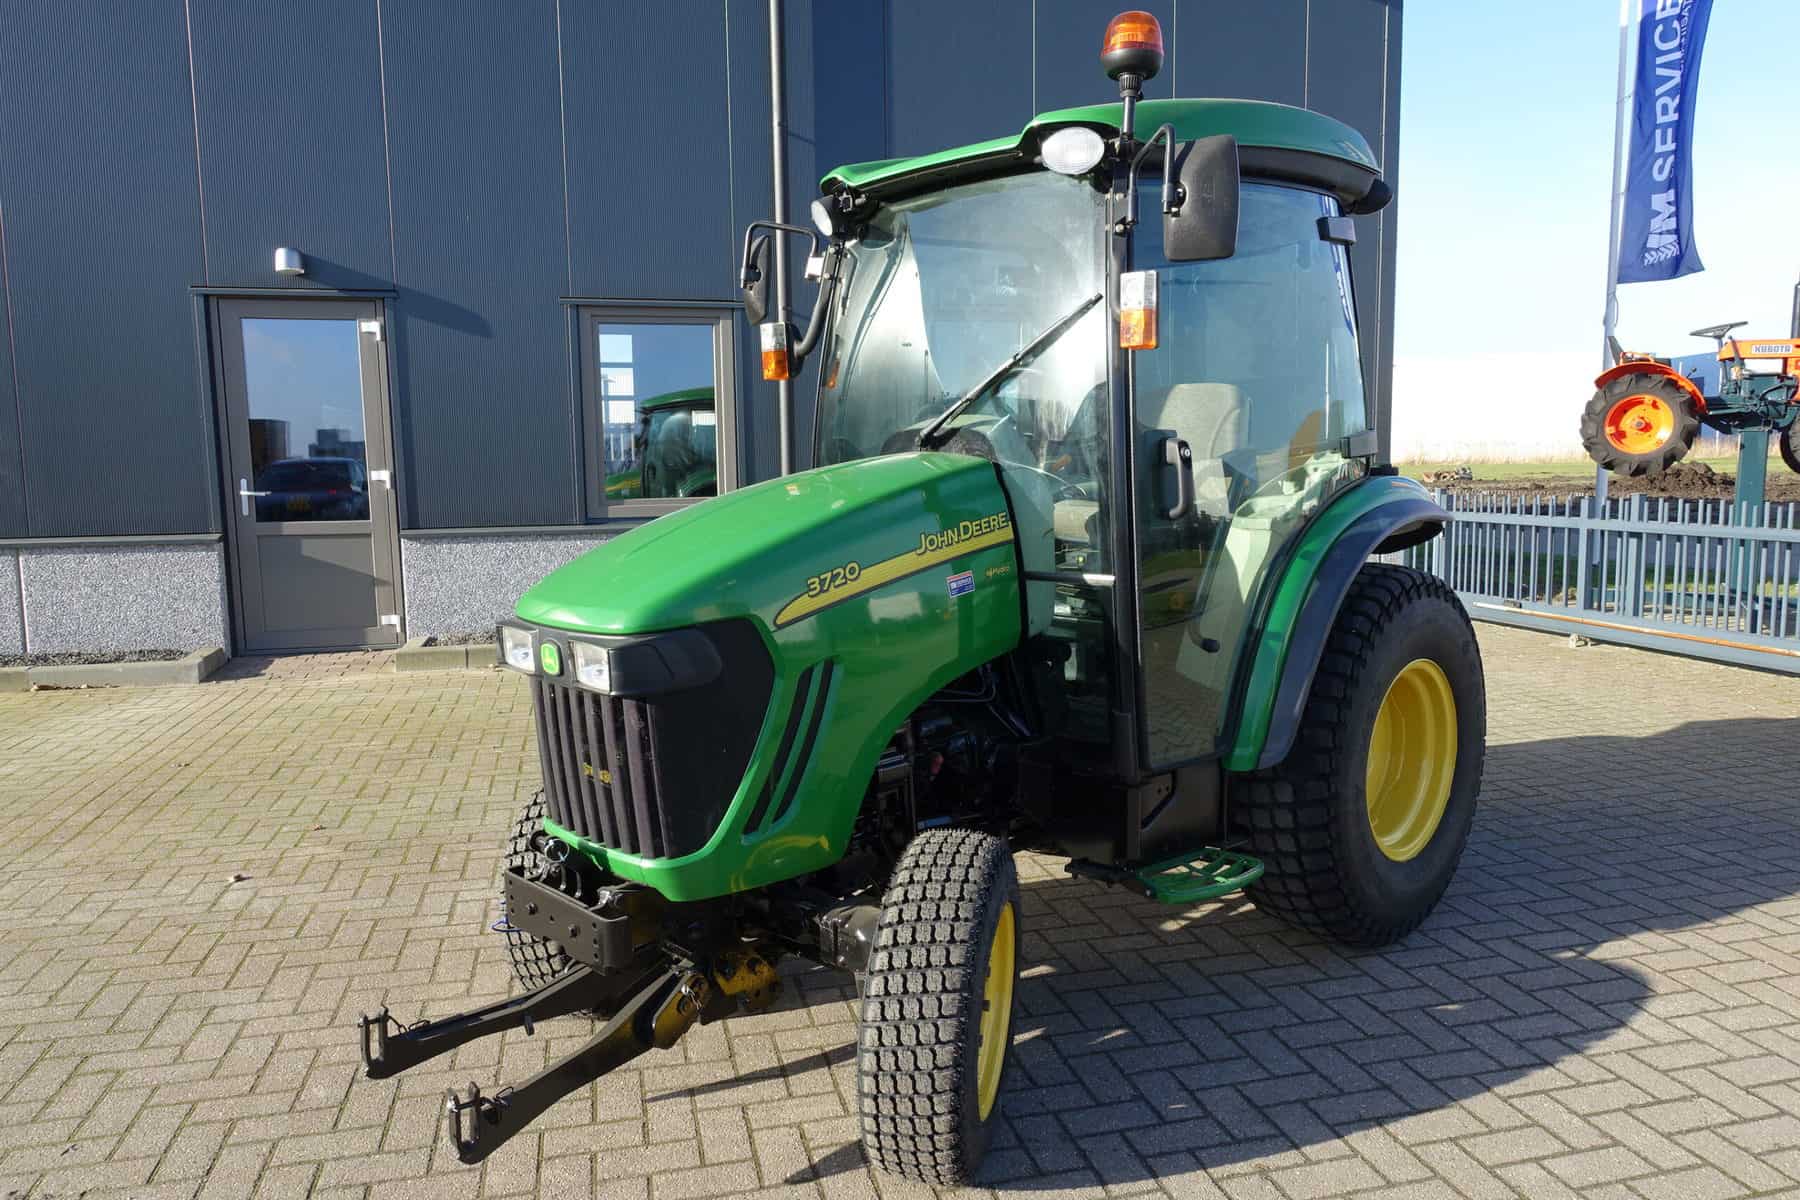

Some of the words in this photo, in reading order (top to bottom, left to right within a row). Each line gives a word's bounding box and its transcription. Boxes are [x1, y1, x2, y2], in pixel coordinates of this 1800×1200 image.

[1652, 0, 1684, 182] SERVICE
[1754, 344, 1791, 353] KUBOTA
[916, 527, 960, 555] JOHN
[959, 512, 1009, 541] DEERE
[807, 561, 861, 597] 3720
